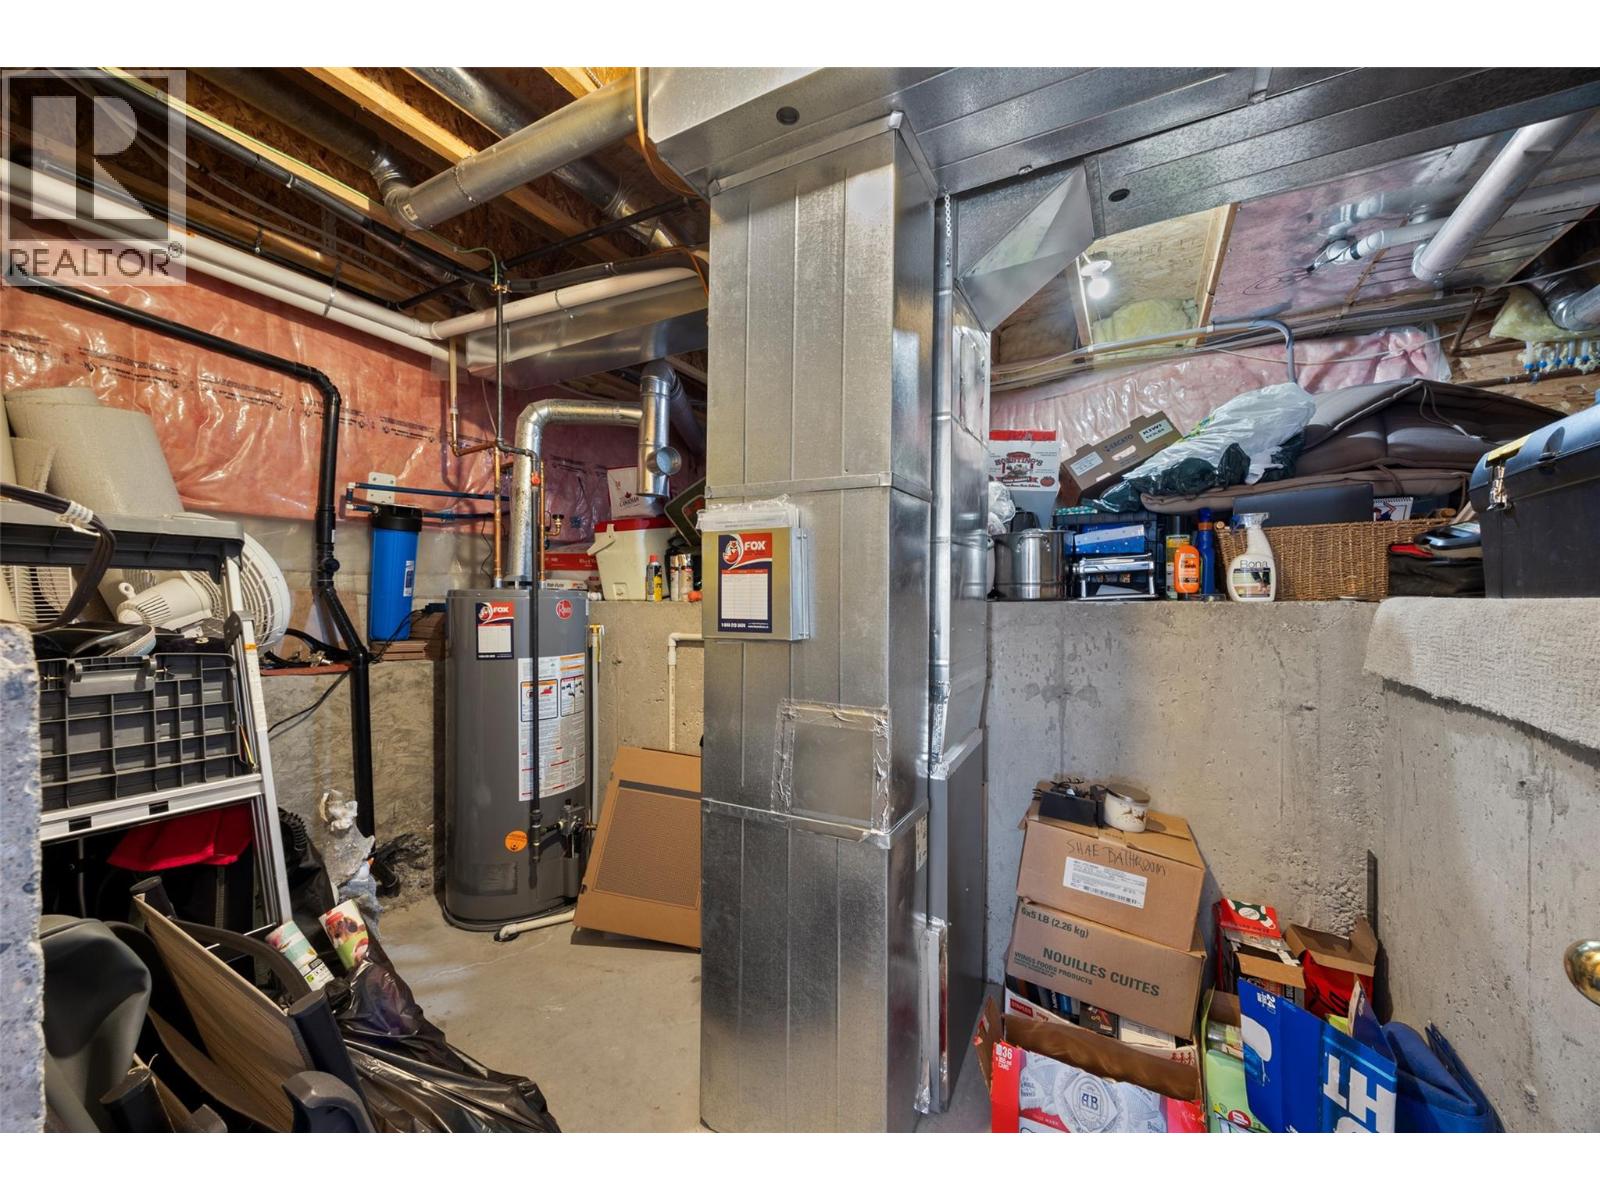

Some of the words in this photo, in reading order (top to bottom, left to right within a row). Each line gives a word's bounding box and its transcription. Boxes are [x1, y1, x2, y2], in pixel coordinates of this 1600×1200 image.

[744, 540, 766, 551] FOX
[1239, 559, 1269, 569] Bona
[492, 605, 509, 613] FOX
[1066, 838, 1099, 857] SHAE
[1105, 846, 1167, 877] BATHROOM
[1038, 913, 1050, 925] LB
[1051, 916, 1072, 933] (2.26
[1073, 925, 1090, 940] kg)
[1042, 947, 1106, 980] NOUILLES
[1109, 971, 1160, 997] CUITES
[1058, 968, 1093, 986] PRODUCTS
[1002, 1046, 1013, 1060] 36
